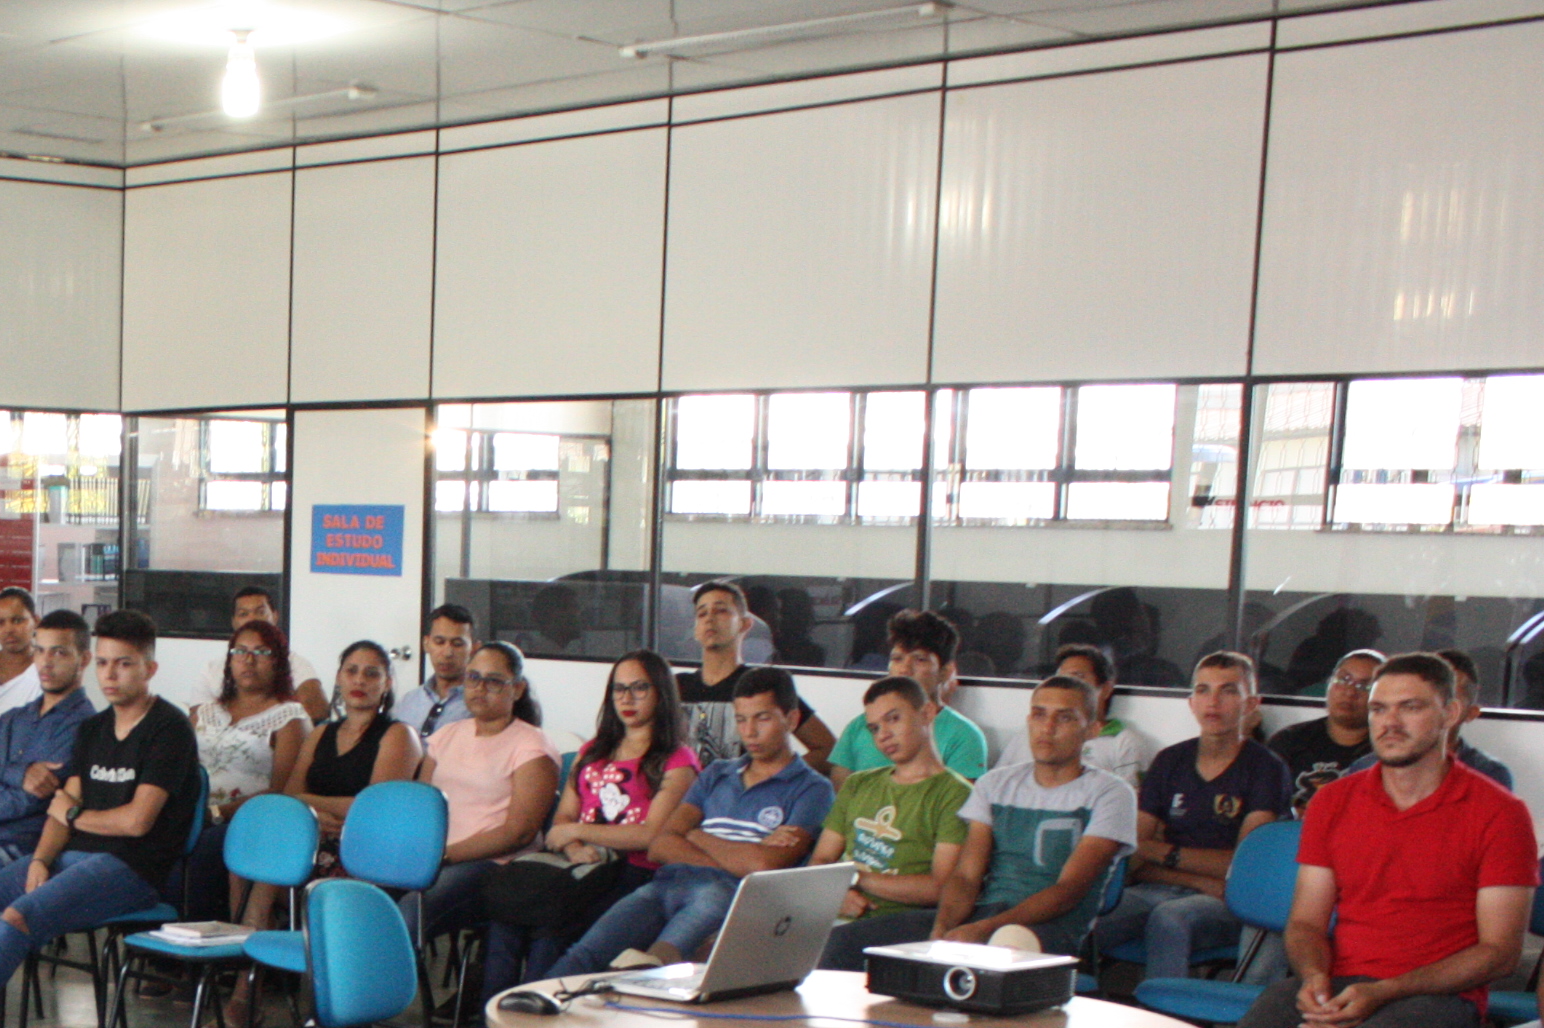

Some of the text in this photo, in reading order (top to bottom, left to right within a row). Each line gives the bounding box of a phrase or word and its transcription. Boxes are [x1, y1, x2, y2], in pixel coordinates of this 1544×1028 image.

[322, 514, 385, 530] SALA DE
[325, 533, 384, 549] ESTUDO
[315, 552, 396, 569] INDIVIDUAL
